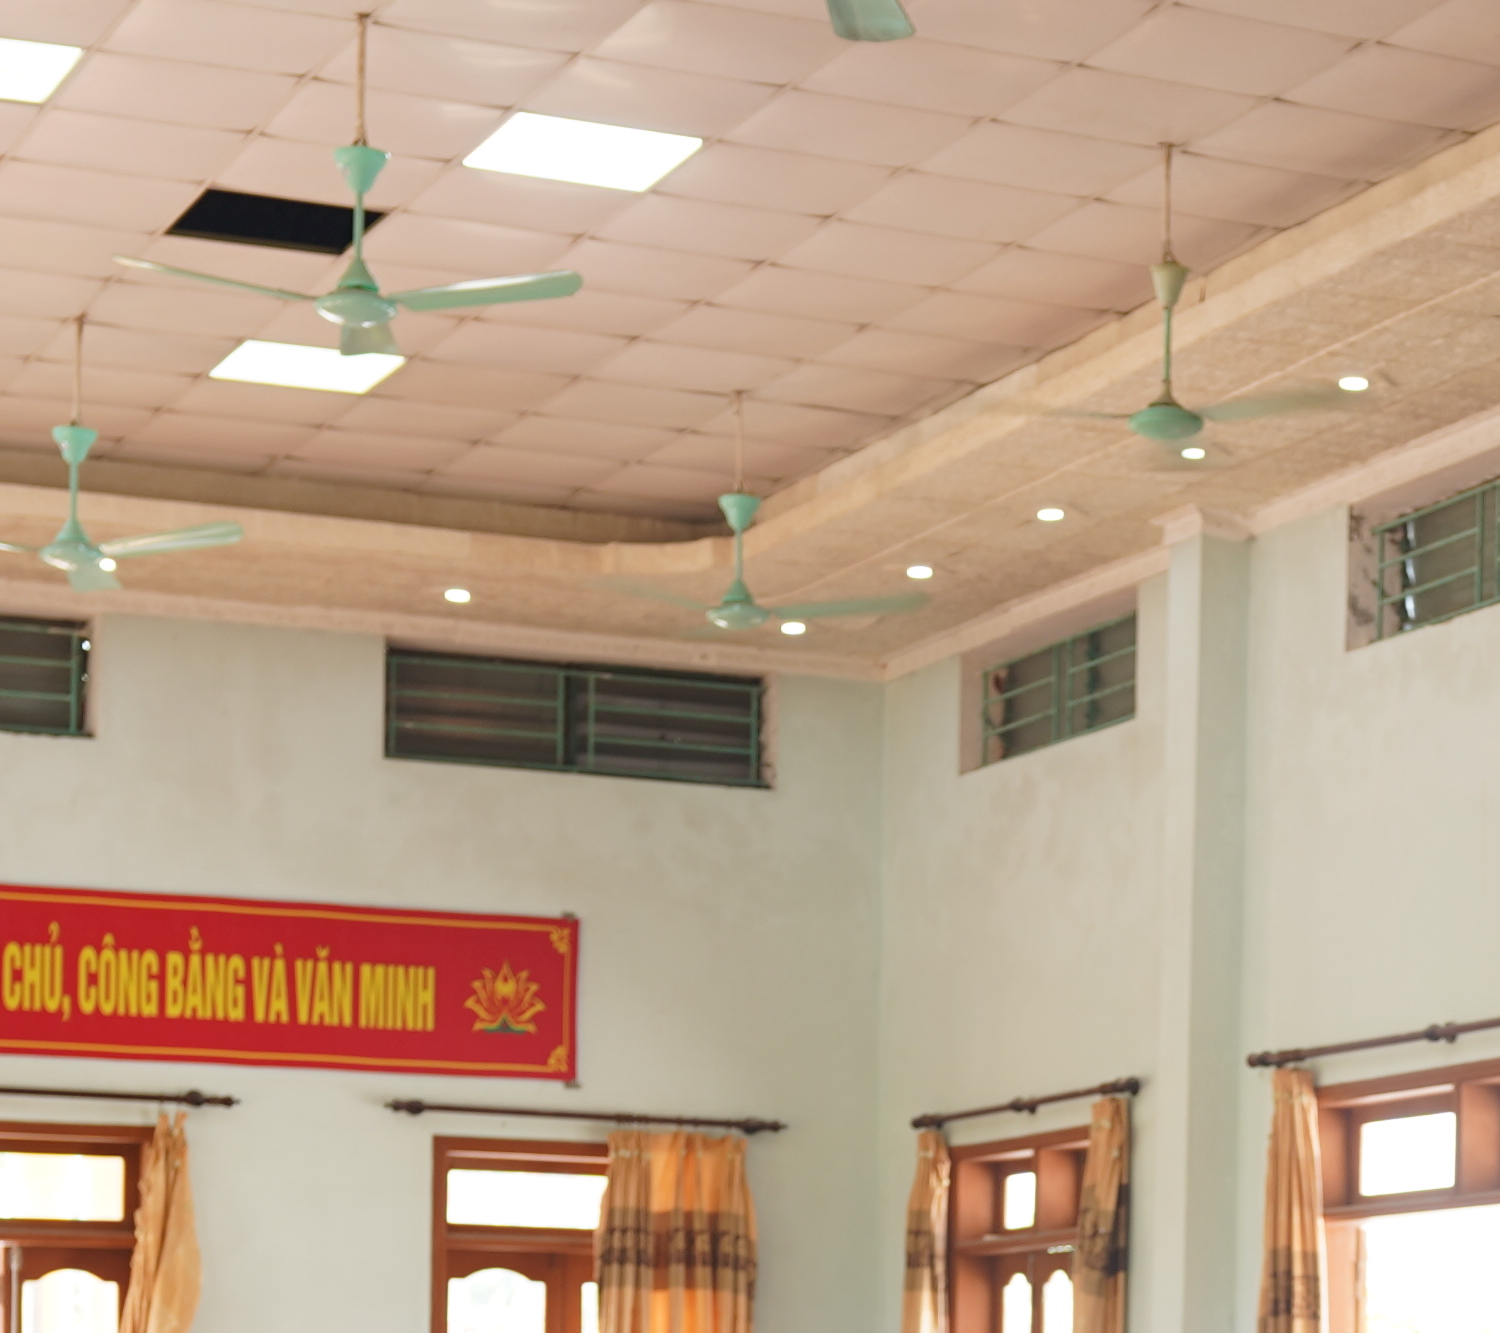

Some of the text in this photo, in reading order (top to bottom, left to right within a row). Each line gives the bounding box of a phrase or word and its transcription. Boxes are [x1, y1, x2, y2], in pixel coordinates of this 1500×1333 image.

[3, 921, 71, 1021] CHỦ,
[78, 932, 159, 1018] CÔNG
[165, 926, 246, 1021] BẰNG
[252, 942, 289, 1025] VÀ
[296, 945, 354, 1027] VĂN
[360, 962, 435, 1031] MINH
